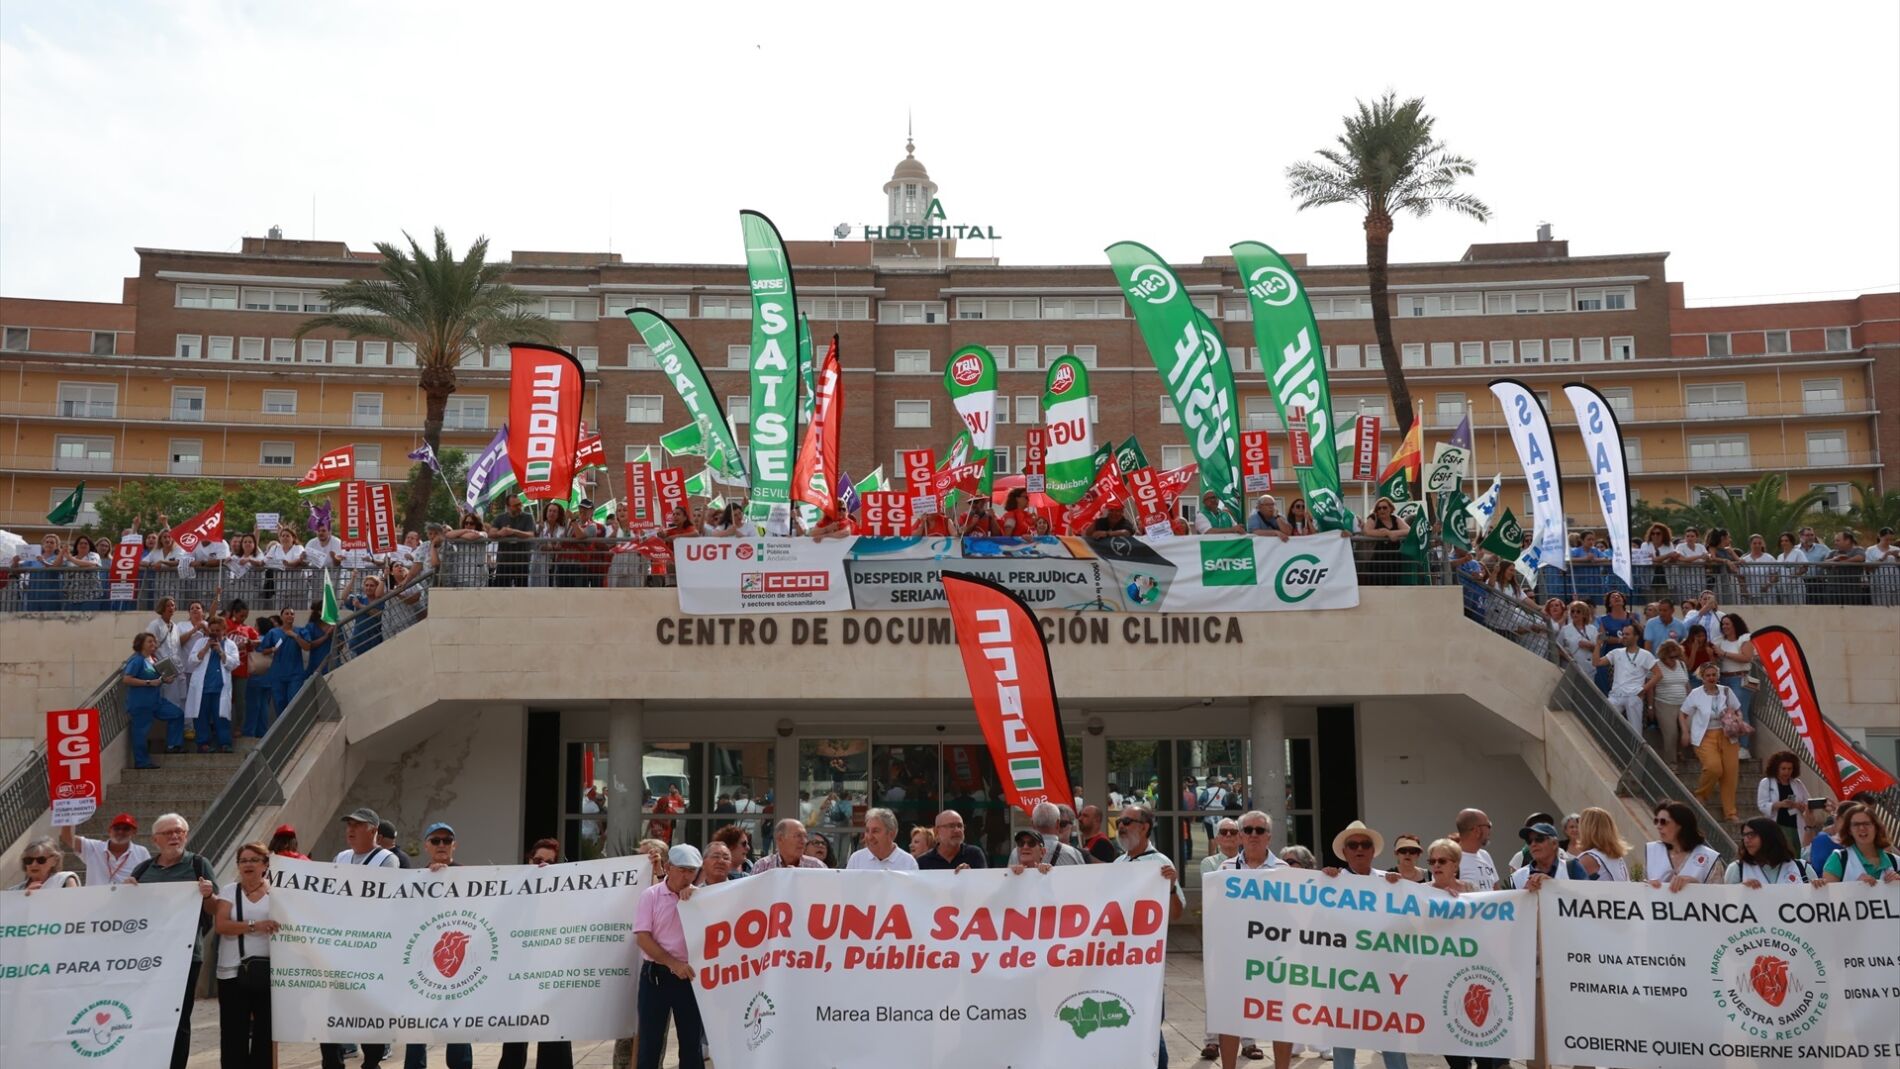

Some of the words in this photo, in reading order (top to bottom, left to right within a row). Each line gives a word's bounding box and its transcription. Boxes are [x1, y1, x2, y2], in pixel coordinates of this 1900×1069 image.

[864, 225, 1002, 240] HOSPITAL
[752, 279, 783, 290] SATSE
[753, 302, 788, 481] SATSE
[1361, 417, 1374, 463] CCOO
[1029, 432, 1041, 475] UGT
[1245, 434, 1263, 475] UGT
[632, 464, 645, 507] CCOO
[910, 452, 931, 497] UGT
[660, 471, 682, 513] UGT
[1133, 470, 1158, 513] UGT
[347, 483, 358, 527] CCOO
[372, 486, 388, 535] CCOO
[867, 494, 882, 536] UGT
[887, 494, 906, 536] UGT
[342, 541, 366, 549] Sevilla
[686, 544, 732, 561] UGT
[116, 546, 137, 583] UGT
[1204, 558, 1253, 571] SATSE
[1285, 568, 1328, 585] CSIF
[768, 576, 825, 588] CCOO
[854, 573, 922, 584] DESPEDIR
[1009, 571, 1088, 584] PERJUDICA
[787, 591, 813, 599] sanidad
[656, 617, 778, 645] CENTRO
[791, 617, 828, 645] DE
[1122, 611, 1244, 645] CLÍNICA
[57, 713, 91, 780] UGT
[266, 869, 353, 897] MAREA
[360, 880, 459, 899] BLANCA
[467, 880, 513, 898] DEL
[517, 869, 639, 896] ALJARAFE
[1225, 876, 1376, 912] SANLÚCAR
[1385, 892, 1421, 917] LA
[1428, 898, 1515, 921] MAYOR
[1558, 898, 1645, 921] MAREA
[1651, 901, 1758, 923] BLANCA
[1778, 902, 1851, 923] CORIA
[1855, 899, 1900, 920] DEL
[64, 921, 85, 934] DE
[91, 918, 148, 933] TOD@S
[295, 925, 342, 937] ATENCIÓN
[344, 930, 392, 940] PRIMARIA
[403, 932, 420, 965] MAREA
[419, 910, 458, 931] BLANCA
[461, 909, 478, 920] DEL
[479, 917, 499, 962] ALJARAFE
[436, 919, 478, 930] SALVEMOS
[510, 927, 558, 939] GOBIERNE
[559, 925, 588, 935] QUIEN
[703, 902, 793, 960] POR
[807, 903, 913, 940] UNA
[930, 900, 1164, 941] SANIDAD
[279, 935, 307, 944] TIEMPO
[309, 936, 316, 945] Y
[318, 937, 332, 946] DE
[334, 940, 377, 950] CALIDAD
[521, 938, 562, 948] SANIDAD
[564, 936, 577, 945] SE
[578, 933, 625, 944] DEFIENDE
[1247, 921, 1291, 943] Por
[1299, 929, 1347, 949] una
[1355, 929, 1478, 958] SANIDAD
[1710, 943, 1728, 976] MAREA
[1727, 926, 1766, 945] BLANCA
[1770, 927, 1801, 944] CORIA
[1801, 942, 1816, 960] DEL
[1735, 938, 1798, 957] SALVEMOS
[56, 961, 100, 975] PARA
[106, 956, 162, 971] TOD@S
[700, 945, 832, 990] Universal,
[843, 943, 960, 970] Pública
[970, 952, 990, 974] y
[999, 946, 1037, 969] de
[1046, 939, 1164, 968] Calidad
[1567, 952, 1592, 964] POR
[1598, 954, 1623, 965] UNA
[1626, 954, 1686, 967] ATENCIÓN
[1843, 958, 1866, 968] POR
[1868, 956, 1895, 967] UNA
[276, 968, 323, 977] NUESTROS
[324, 971, 375, 981] DERECHOS
[377, 973, 384, 981] A
[287, 980, 328, 989] SANIDAD
[329, 981, 366, 991] PÚBLICA
[417, 969, 447, 990] NUESTRA
[450, 965, 482, 990] SANIDAD
[508, 973, 521, 981] LA
[522, 970, 563, 980] SANIDAD
[566, 968, 580, 977] NO
[583, 968, 596, 977] SE
[538, 981, 551, 990] SE
[552, 979, 601, 989] DEFIENDE
[1245, 956, 1381, 994] PÚBLICA
[1389, 973, 1408, 995] Y
[408, 978, 419, 990] NO
[425, 991, 442, 1001] LOS
[445, 974, 488, 1001] RECORTES
[1570, 982, 1629, 995] PRIMARIA
[1632, 985, 1641, 996] A
[1643, 986, 1688, 998] TIEMPO
[1844, 987, 1880, 1000] DIGNA
[1882, 987, 1889, 998] Y
[816, 1006, 870, 1022] Marea
[876, 1006, 933, 1022] Blanca
[939, 1005, 961, 1021] de
[966, 1005, 1027, 1021] Camas
[1243, 997, 1283, 1021] DE
[1291, 1002, 1425, 1034] CALIDAD
[1713, 989, 1727, 1008] NO
[1727, 1013, 1736, 1021] A
[1741, 1021, 1768, 1039] LOS
[1776, 992, 1829, 1040] RECORTES
[1728, 989, 1774, 1026] NUESTRA
[1778, 990, 1814, 1026] SANIDAD
[327, 1016, 385, 1029] SANIDAD
[389, 1014, 449, 1029] PÚBLICA
[453, 1017, 462, 1028] Y
[465, 1016, 484, 1028] DE
[488, 1014, 550, 1028] CALIDAD
[1564, 1035, 1648, 1053] GOBIERNE
[1652, 1040, 1704, 1056] QUIEN
[1709, 1043, 1793, 1059] GOBIERNE
[1798, 1045, 1869, 1059] SANIDAD
[1874, 1043, 1891, 1057] SE
